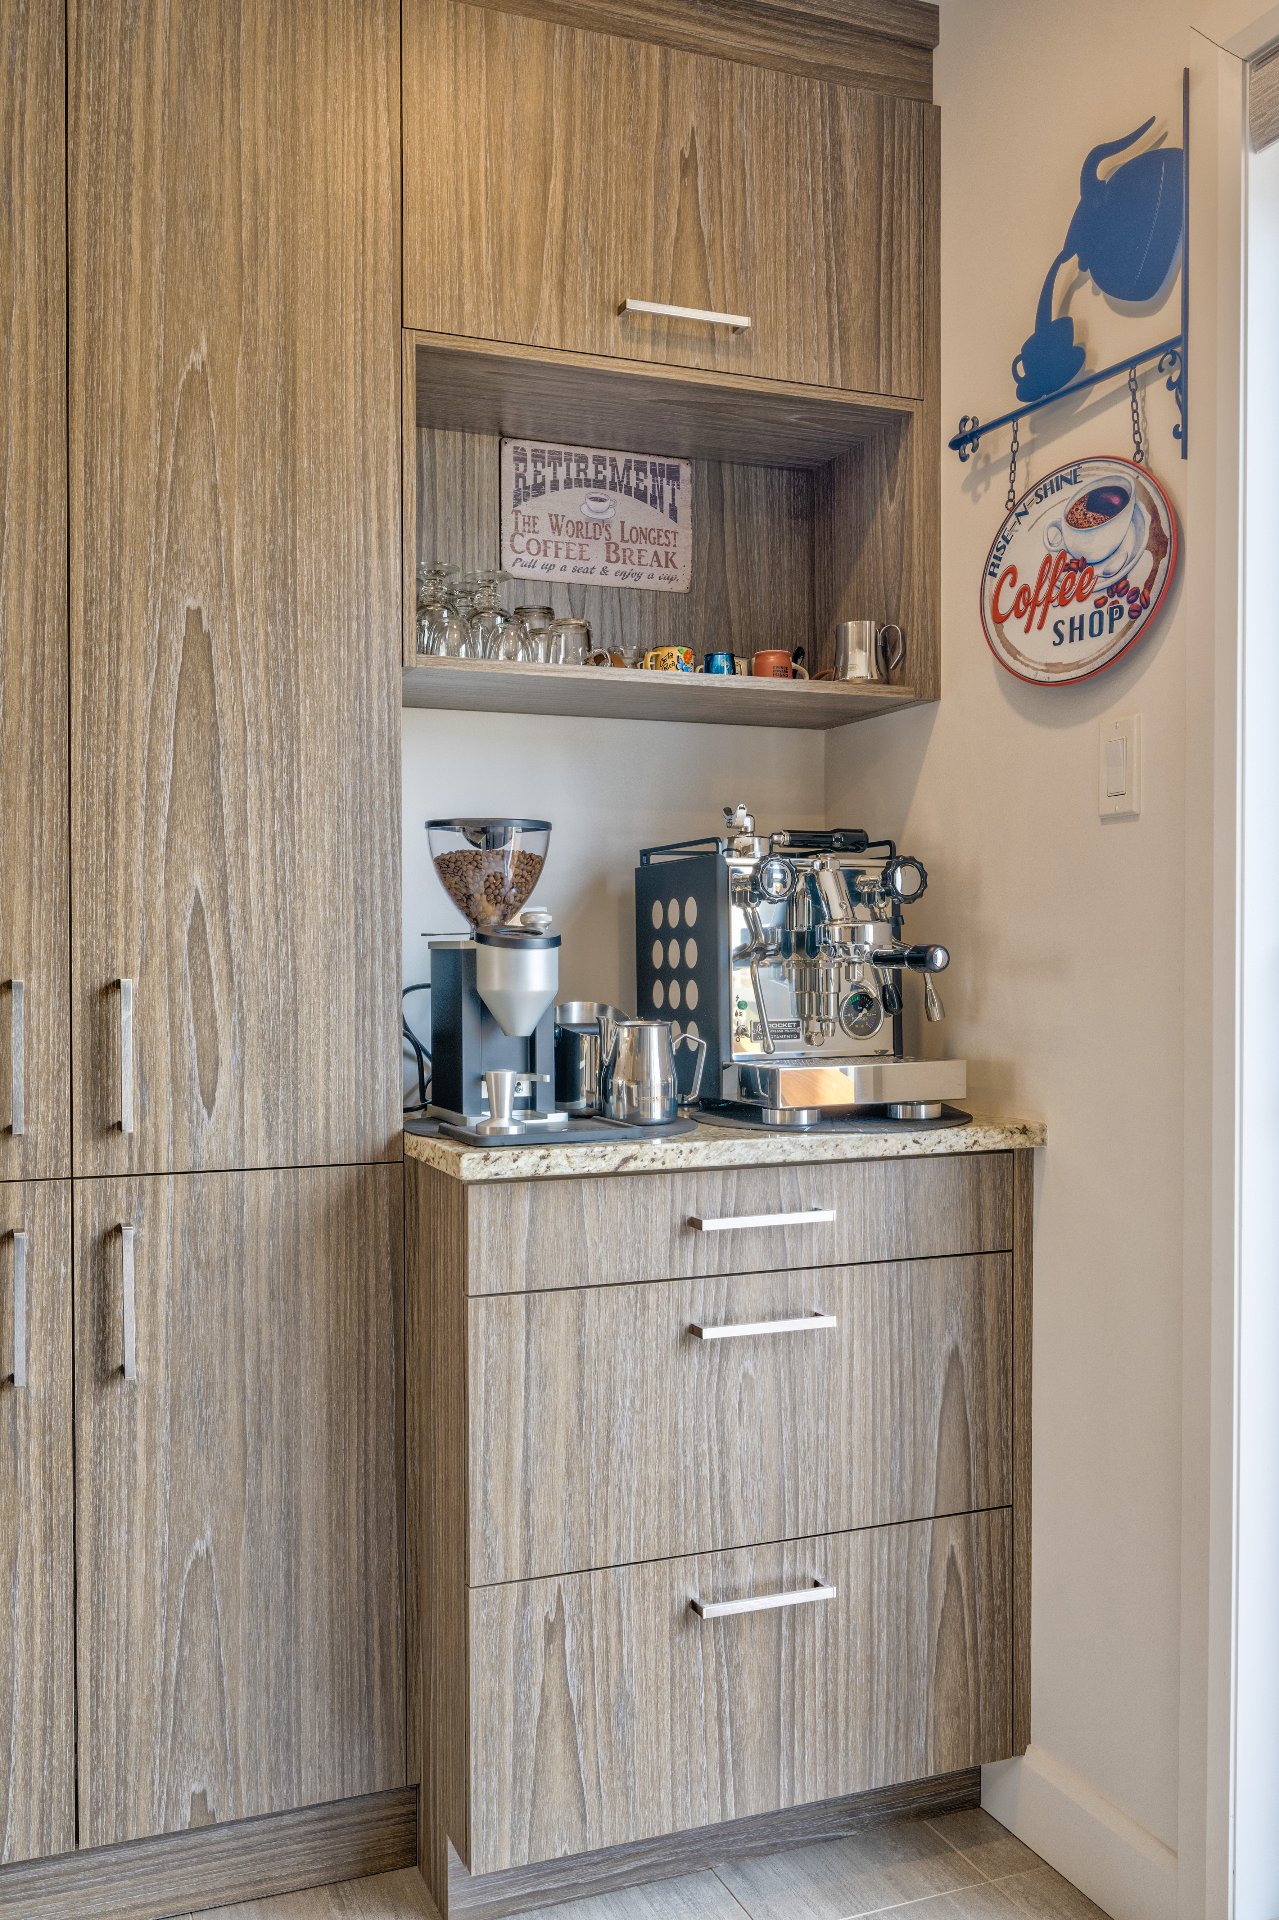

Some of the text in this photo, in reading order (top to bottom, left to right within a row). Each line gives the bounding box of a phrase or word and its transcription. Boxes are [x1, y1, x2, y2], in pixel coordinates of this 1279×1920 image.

[513, 446, 681, 524] RETIREMENT
[511, 509, 679, 547] THE WORLD'S LONGEST
[510, 532, 679, 569] COFFEE BREAK
[512, 557, 537, 569] Pull
[541, 563, 556, 573] up
[572, 564, 596, 574] seat
[600, 567, 609, 576] &
[614, 568, 643, 581] enjoy
[992, 549, 1098, 634] Coffee
[1052, 604, 1125, 646] SHOP
